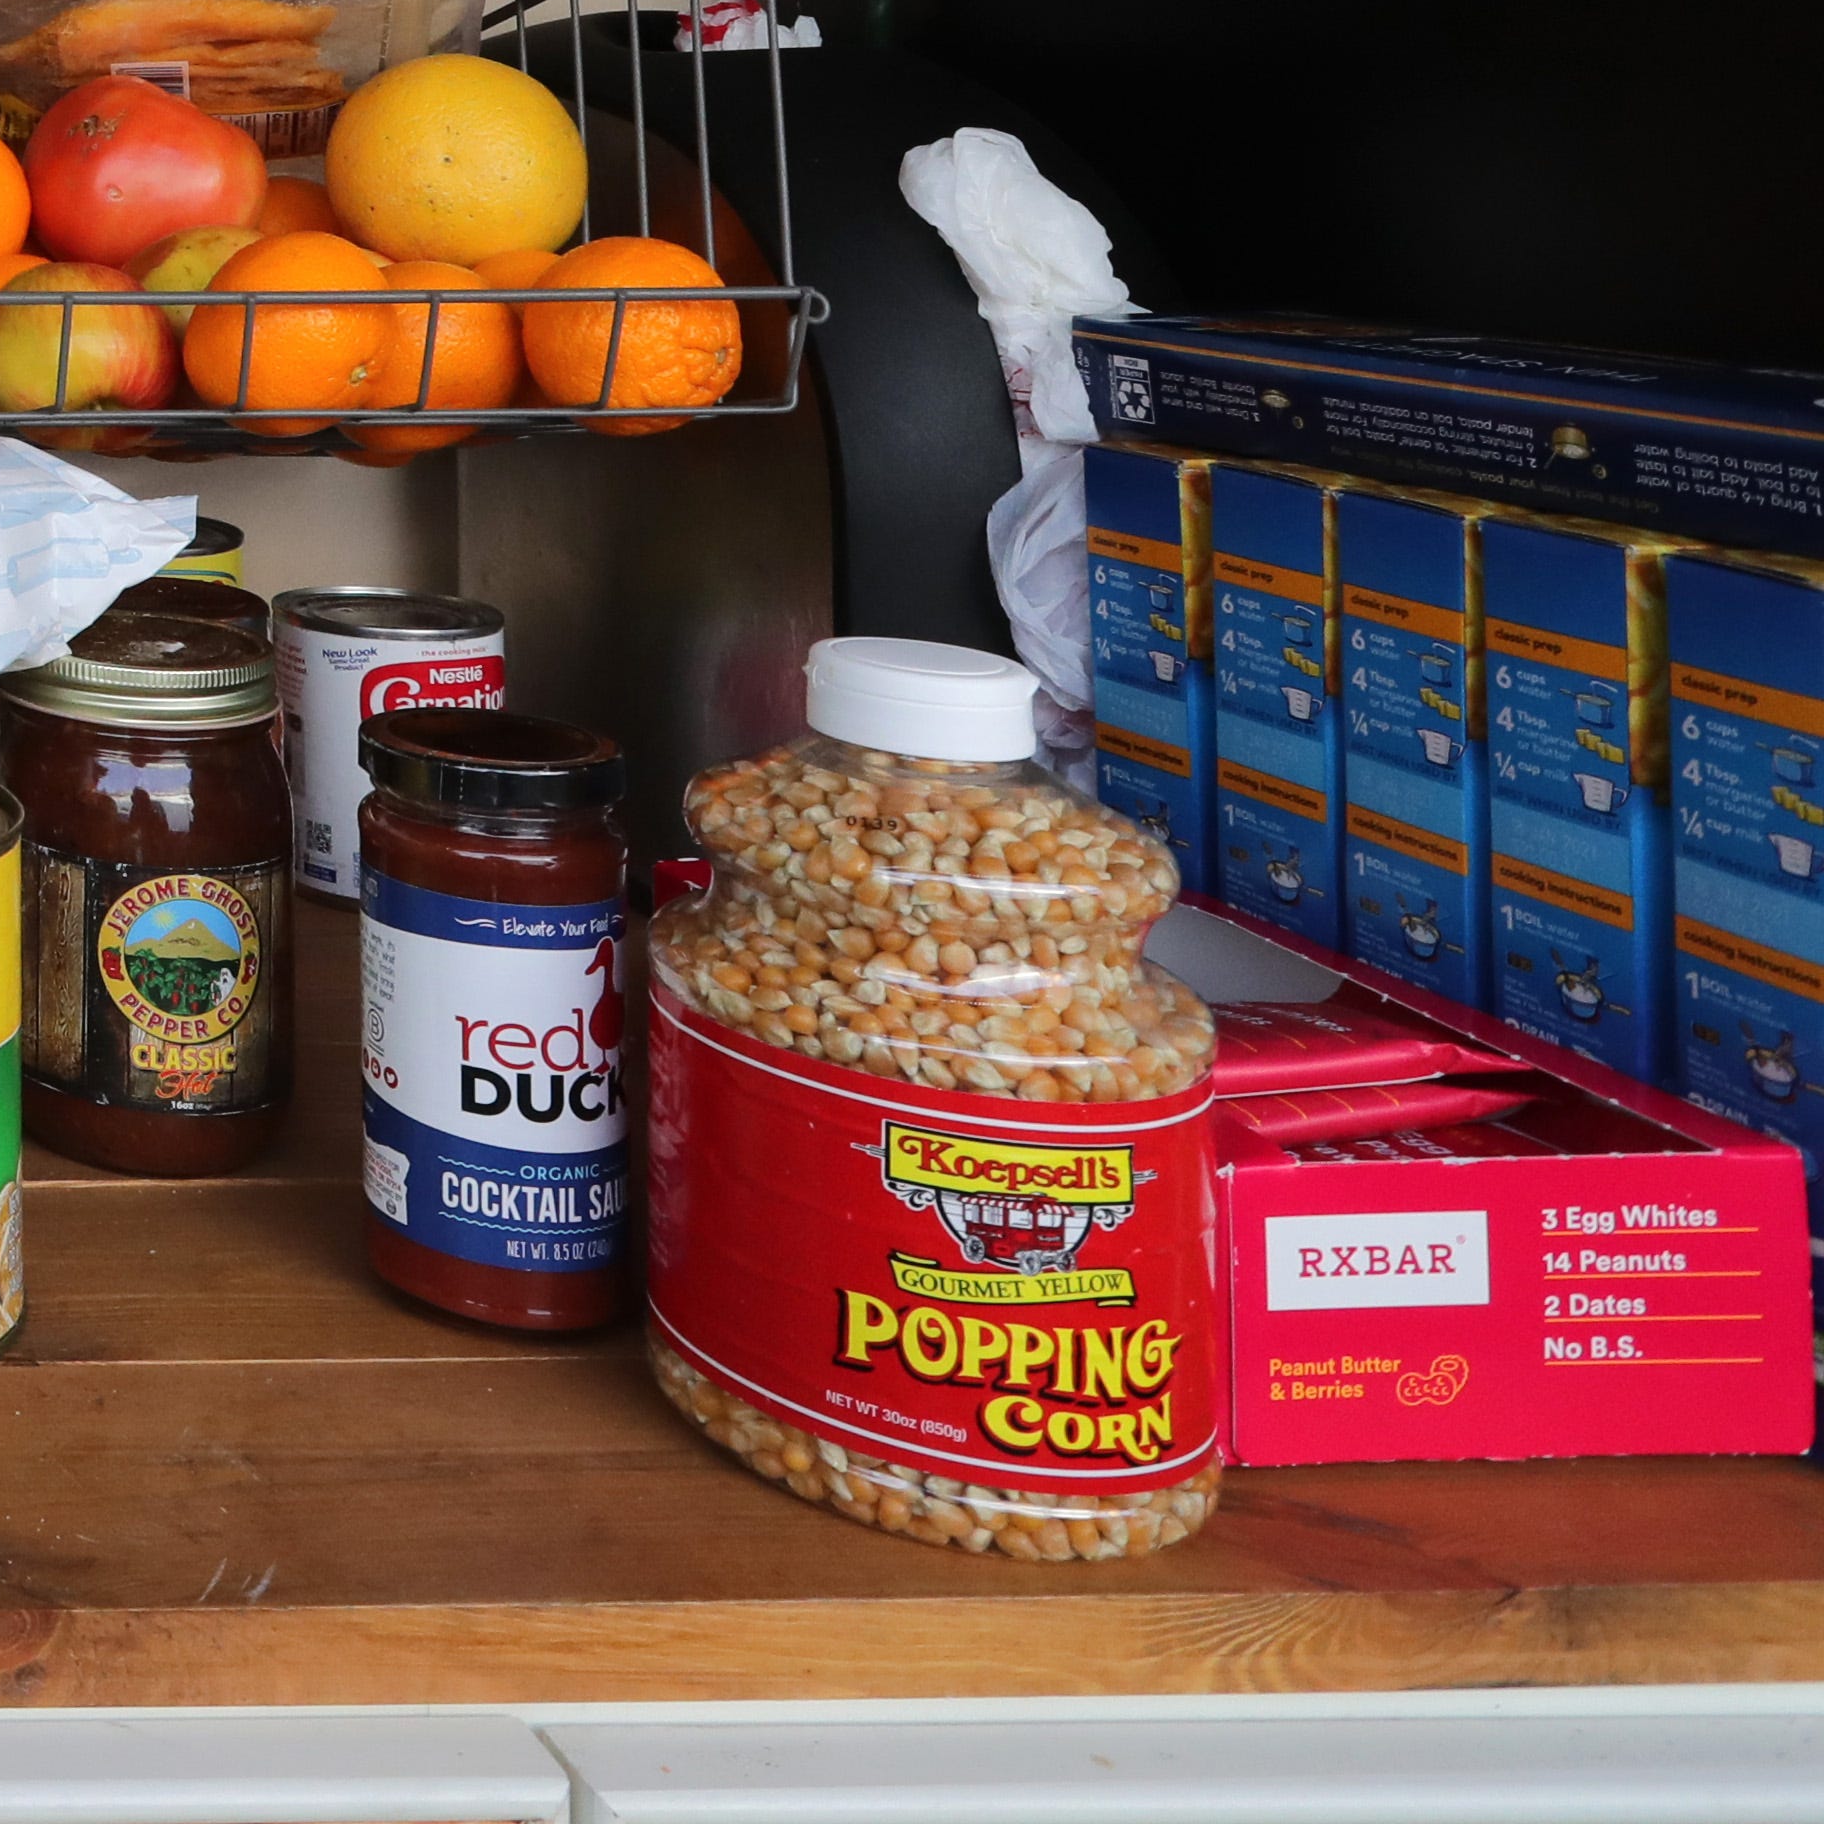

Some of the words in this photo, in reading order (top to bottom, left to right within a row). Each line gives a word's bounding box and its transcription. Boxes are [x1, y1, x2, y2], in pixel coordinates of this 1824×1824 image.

[131, 1044, 236, 1072] CLASSIC
[456, 1011, 584, 1072] red
[520, 1164, 599, 1180] ORGANIC
[898, 1134, 1122, 1192] Koepsell's
[442, 1172, 583, 1222] COCKTAIL
[1542, 1209, 1558, 1230] 3
[1566, 1208, 1615, 1234] Egg
[1621, 1205, 1718, 1229] Whites
[1298, 1244, 1455, 1278] RXBAR
[1542, 1253, 1572, 1273] 14
[1580, 1251, 1686, 1273] Peanuts
[845, 1290, 1182, 1399] POPPING
[983, 1396, 1173, 1463] CORN
